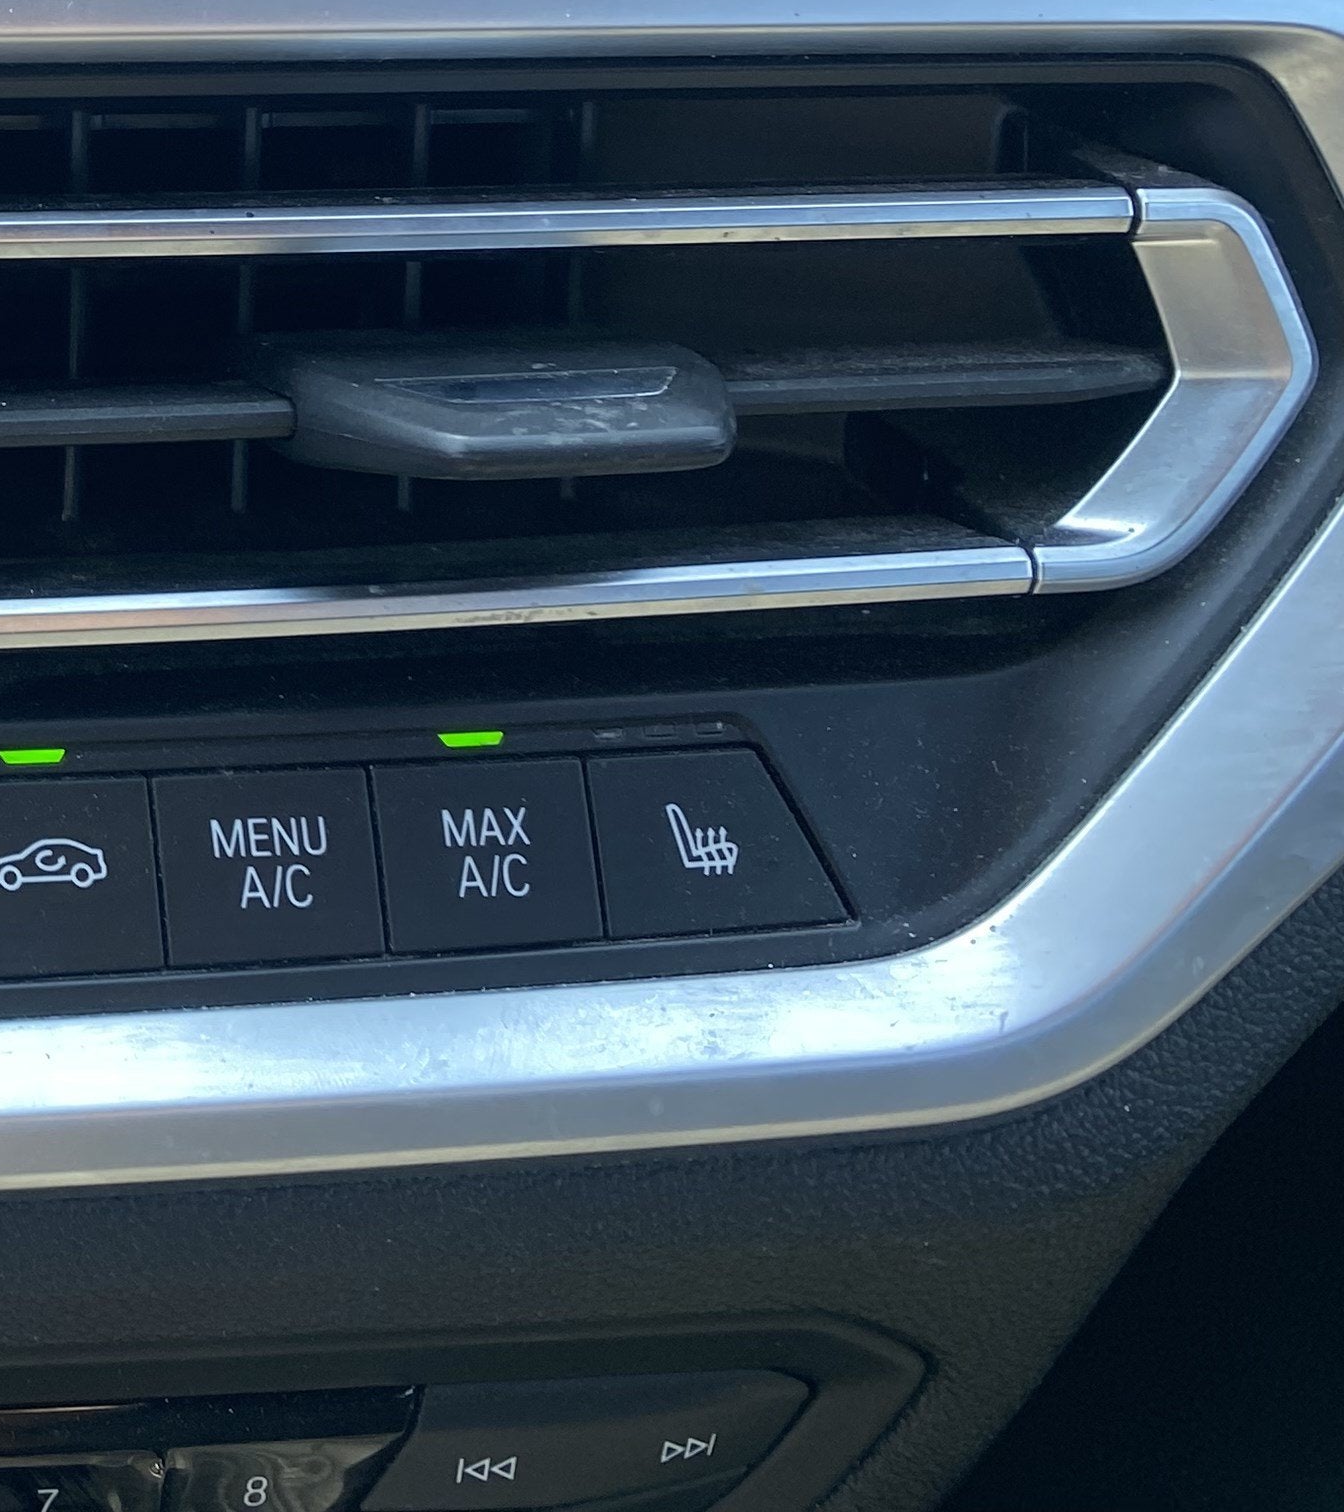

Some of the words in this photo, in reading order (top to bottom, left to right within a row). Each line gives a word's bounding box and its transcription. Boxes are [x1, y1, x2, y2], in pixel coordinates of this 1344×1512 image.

[210, 816, 327, 858] MENU
[441, 807, 531, 847] MAX
[241, 864, 313, 909] A/C
[459, 853, 530, 898] A/C
[243, 1476, 268, 1507] 8
